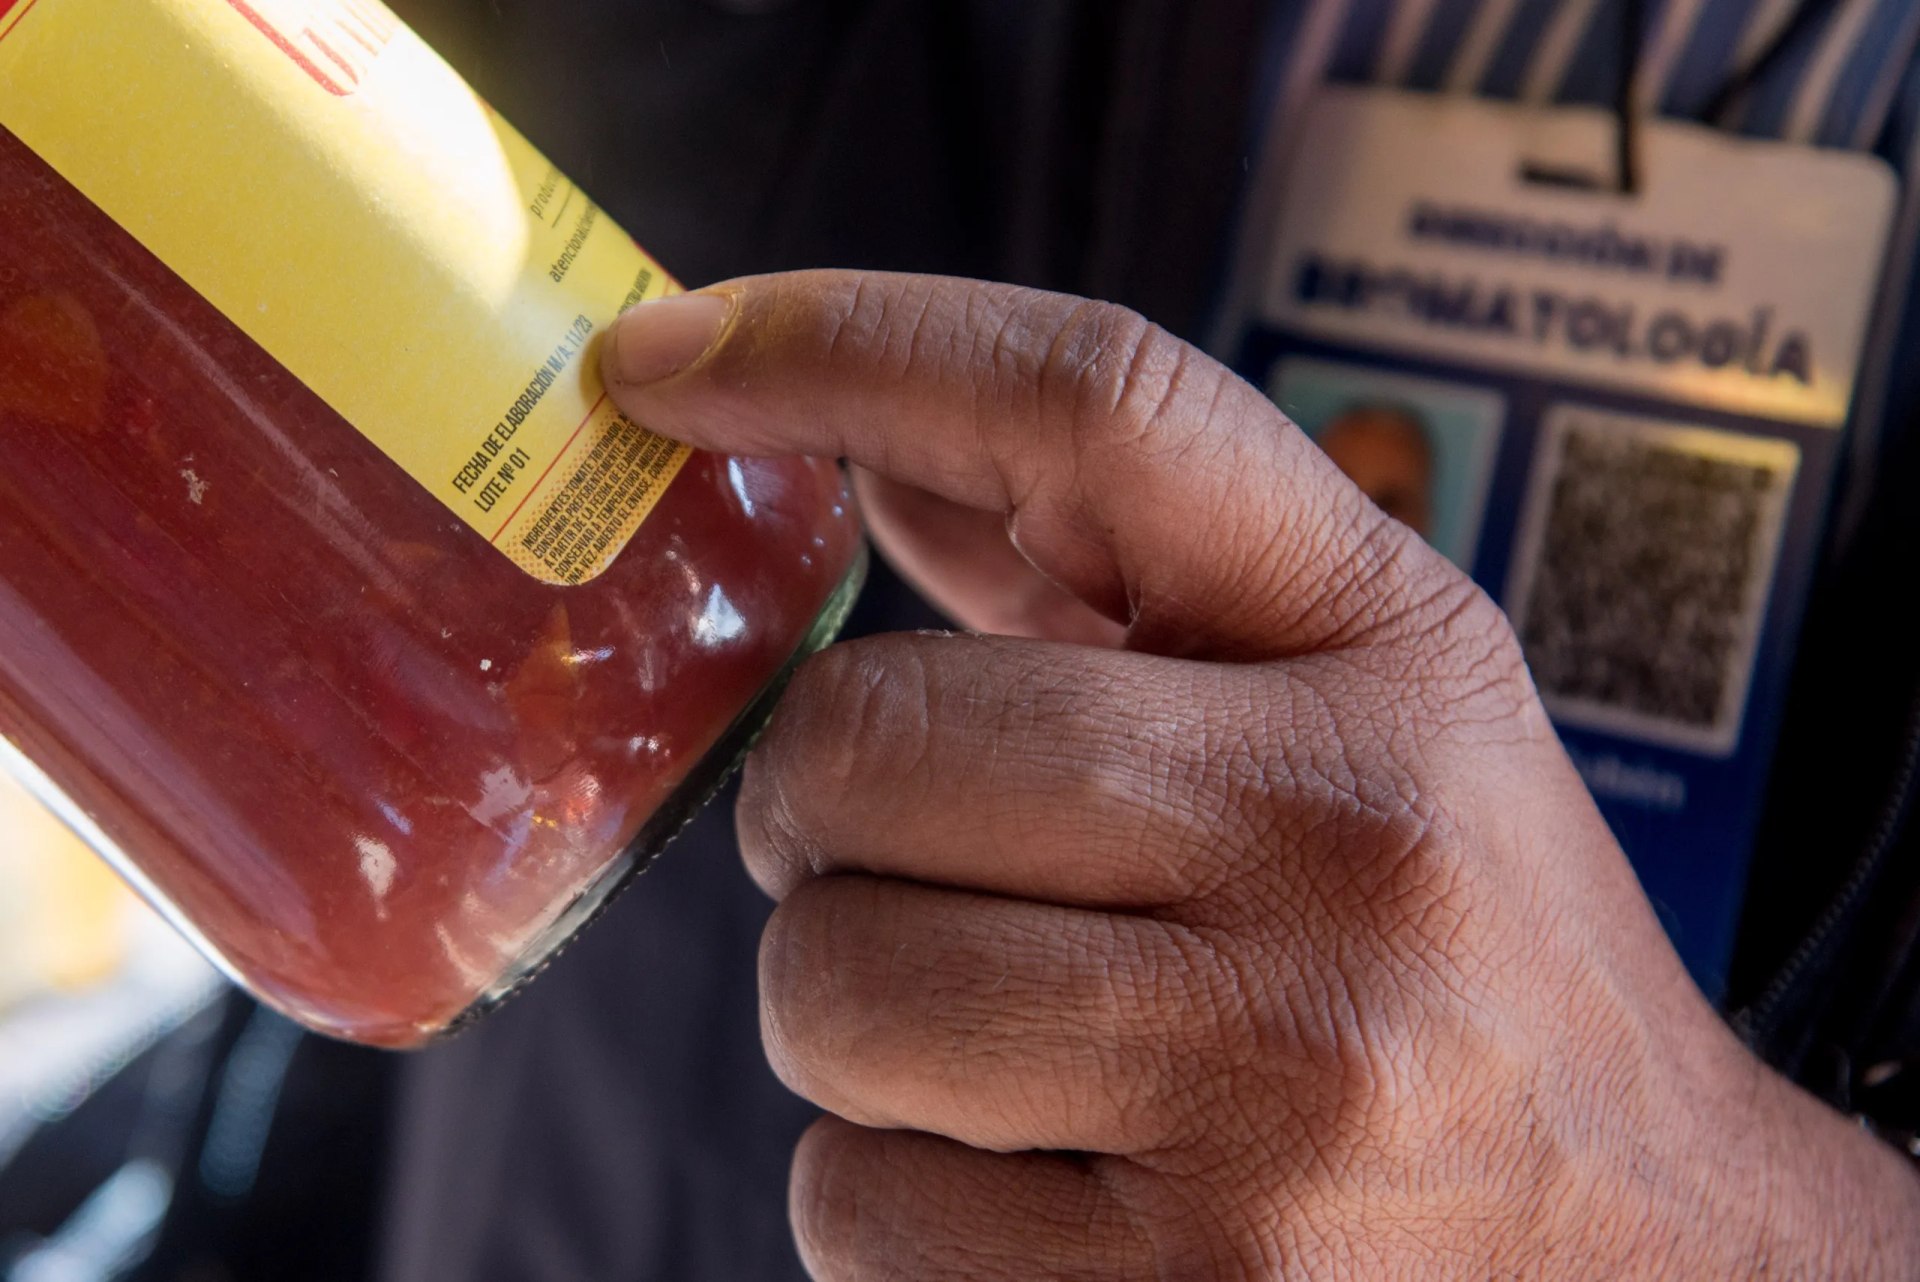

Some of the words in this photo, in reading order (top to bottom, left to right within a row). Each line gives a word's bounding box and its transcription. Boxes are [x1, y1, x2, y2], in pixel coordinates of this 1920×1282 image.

[1297, 254, 1813, 384] BROMATOLOGÍA
[452, 450, 491, 494] FECHA
[482, 433, 503, 456] DE
[494, 365, 555, 441] ELABORACIÓN
[564, 314, 592, 347] 11/23
[474, 477, 506, 512] LOTE
[509, 447, 529, 469] 01
[531, 513, 570, 559] CONSUMIR
[564, 442, 624, 517] PREFERENTEMENTE
[616, 420, 641, 448] ANTES
[542, 557, 554, 569] A
[548, 527, 577, 561] PARTIR
[570, 516, 587, 533] DE
[580, 504, 595, 521] LA
[588, 480, 614, 510] FECHA
[607, 468, 622, 485] DE
[553, 527, 597, 578] CONSERVAR
[590, 520, 602, 532] A
[596, 467, 642, 524] TEMPERATURA
[579, 549, 597, 568] VEZ
[591, 516, 624, 553] ABIERTO
[616, 505, 631, 520] EL
